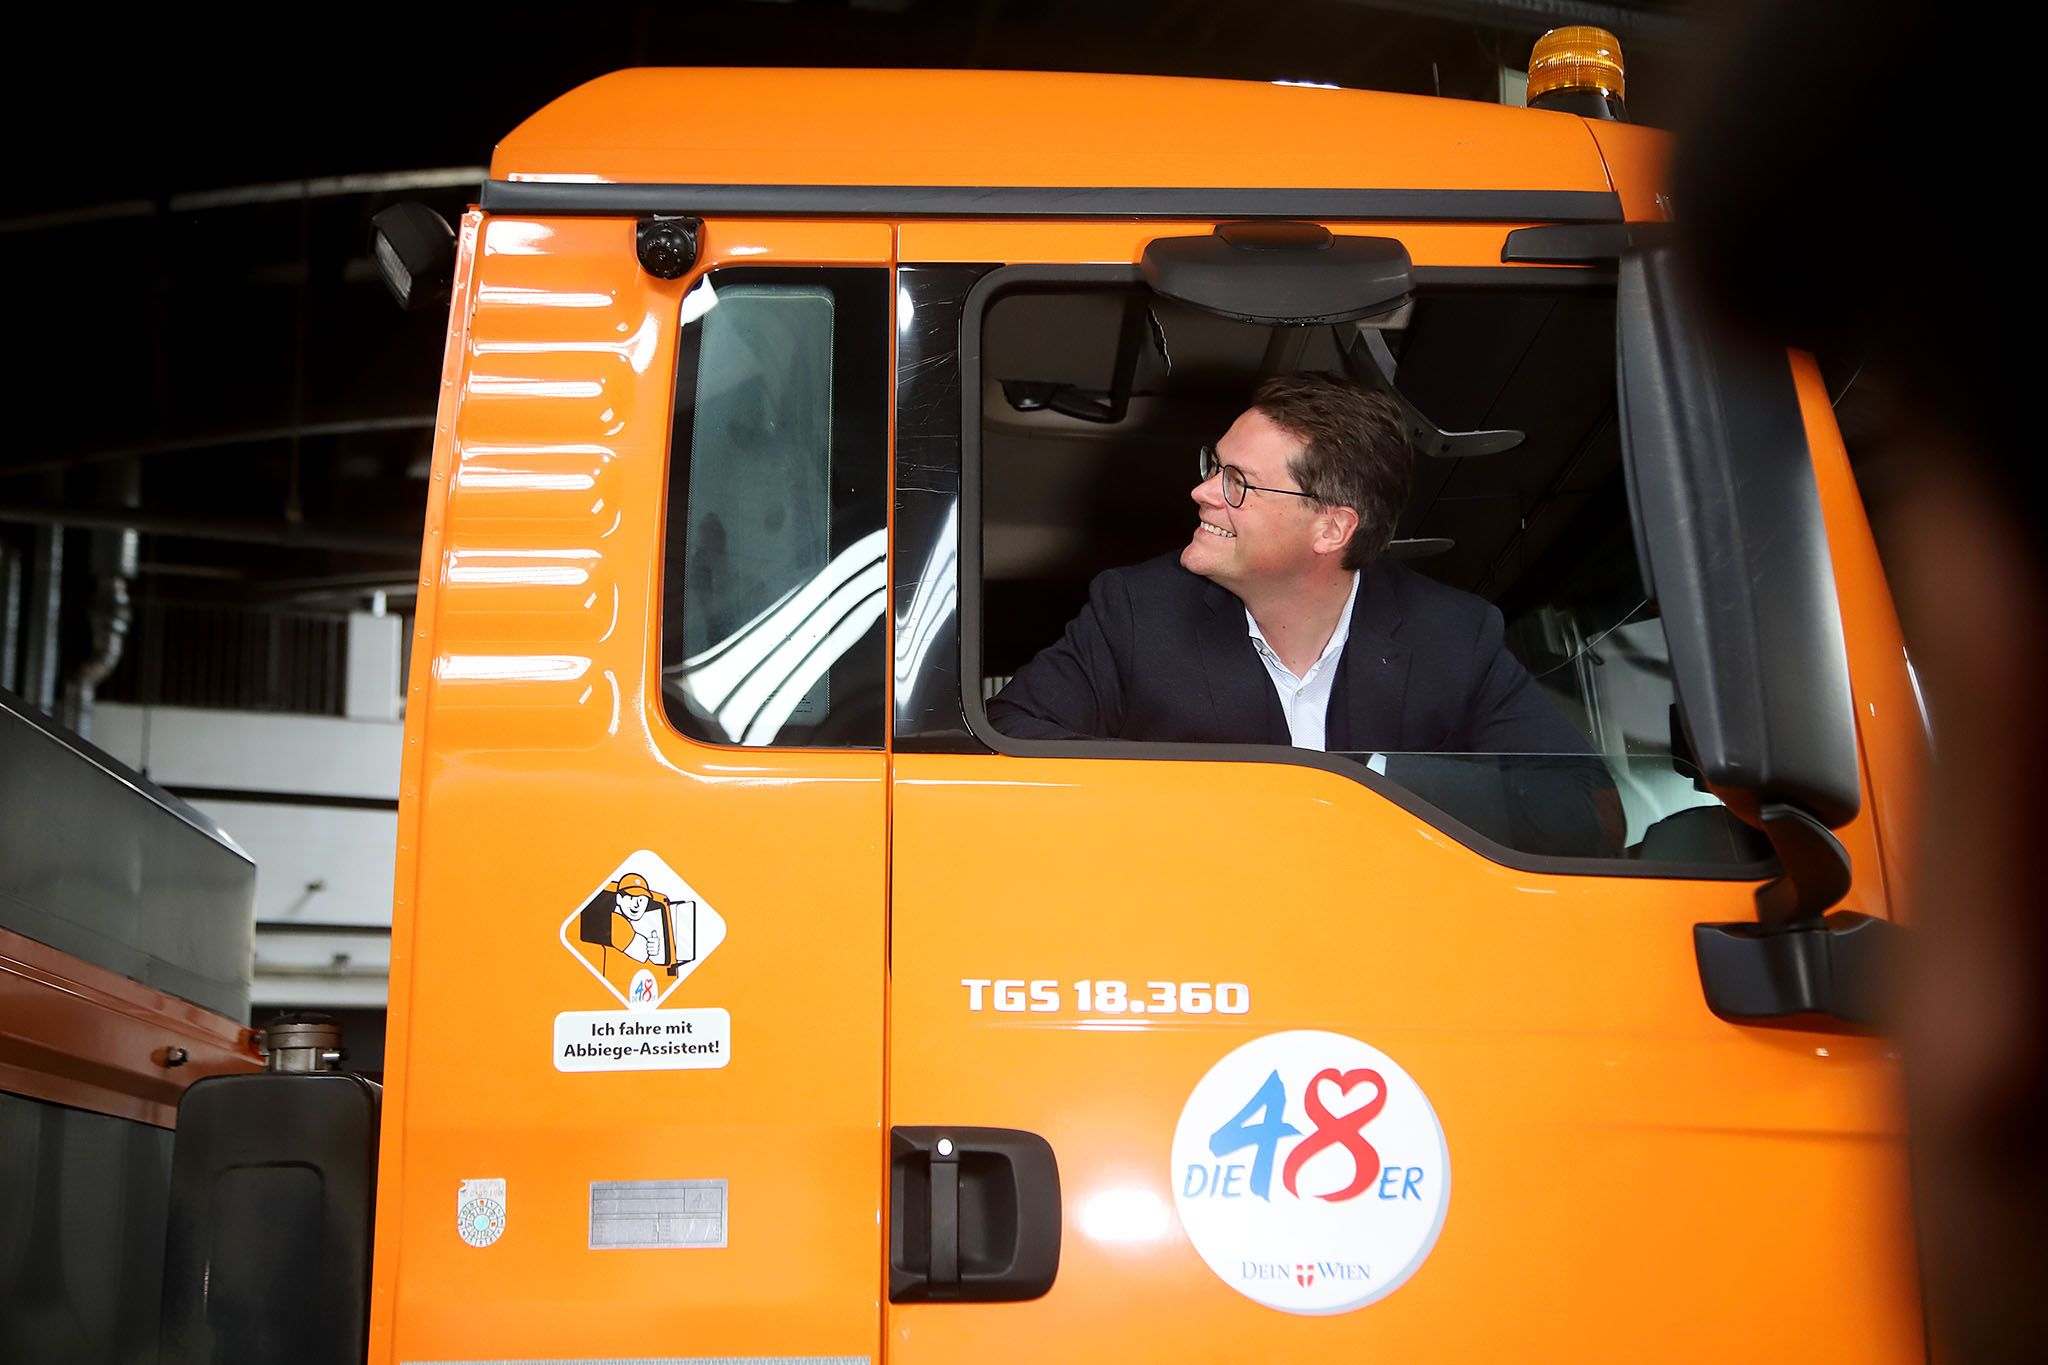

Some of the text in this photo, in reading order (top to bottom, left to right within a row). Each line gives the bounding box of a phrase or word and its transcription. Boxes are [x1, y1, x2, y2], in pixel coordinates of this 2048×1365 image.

[961, 978, 1251, 1015] TGS 18.360
[591, 1020, 693, 1037] Ich fahre mit
[563, 1039, 720, 1060] Abbiege-Assistent!
[1182, 1163, 1246, 1199] DIE
[1241, 1261, 1372, 1281] DEIN WIEN
